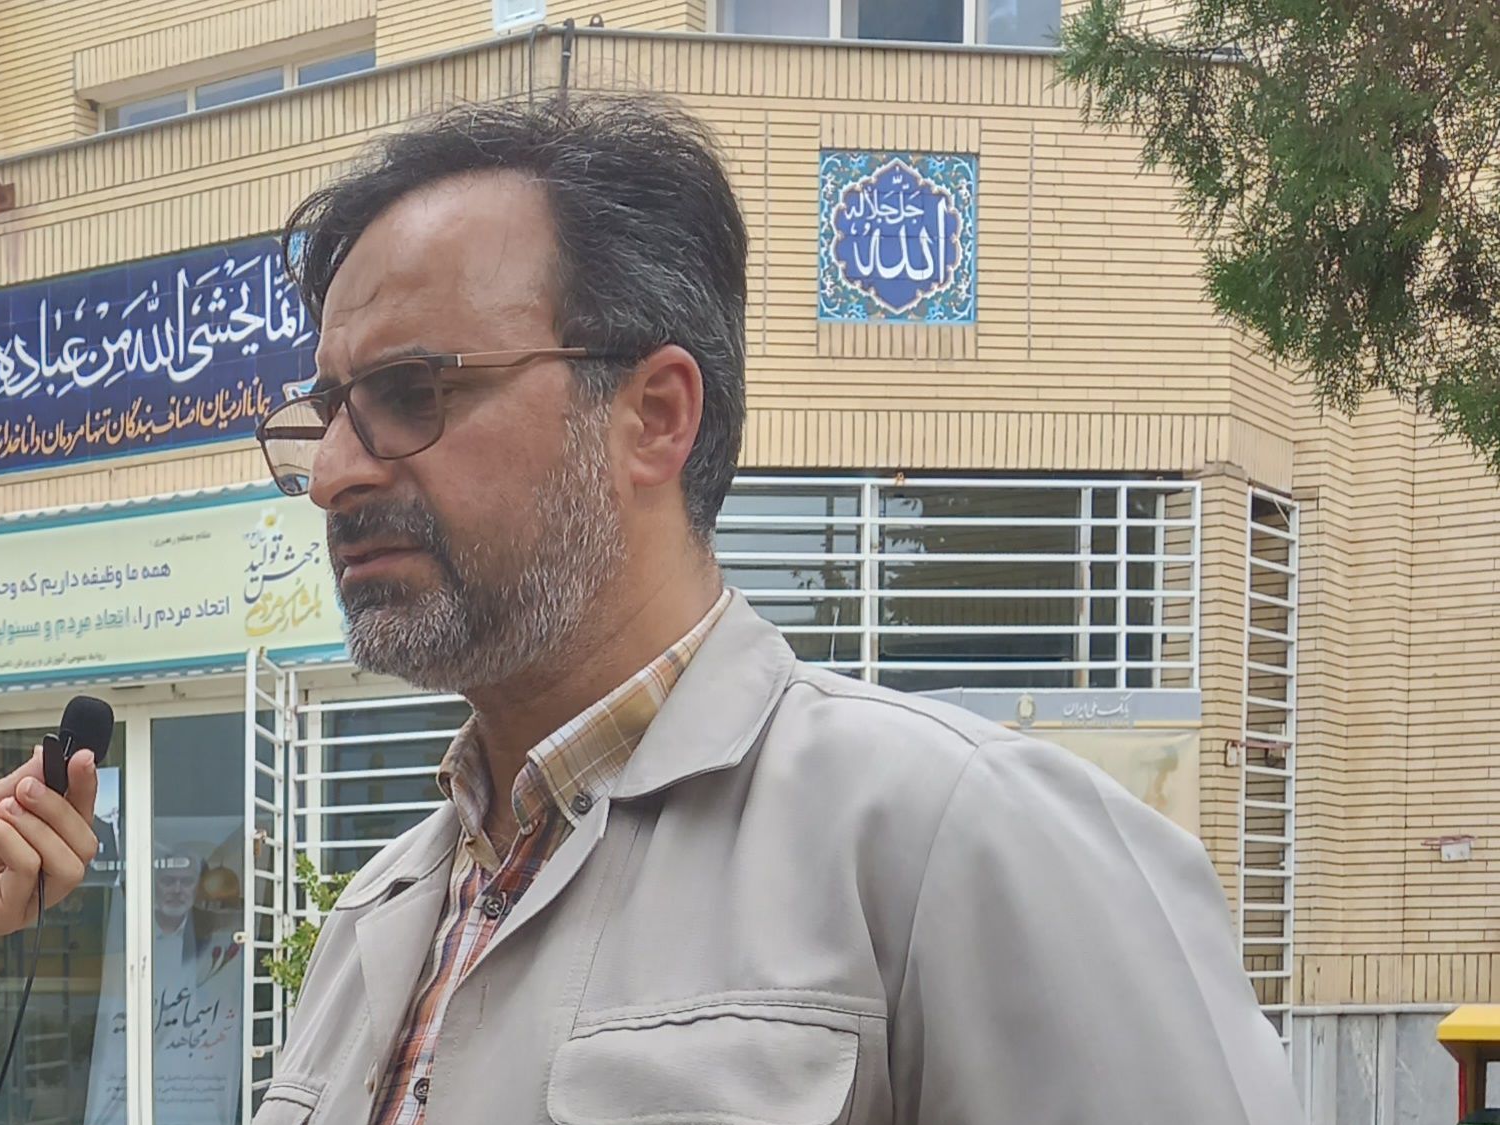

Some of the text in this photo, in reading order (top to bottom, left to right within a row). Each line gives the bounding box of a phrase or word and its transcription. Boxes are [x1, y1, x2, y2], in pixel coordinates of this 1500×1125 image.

[20, 573, 38, 592] که
[82, 565, 122, 589] وظیفه
[126, 563, 138, 580] ما
[142, 563, 171, 580] همه
[41, 570, 79, 596] داریم
[96, 606, 130, 628] اتحاد
[155, 606, 191, 628] مردم
[196, 596, 230, 618] اتحاد
[55, 615, 91, 638] مردم
